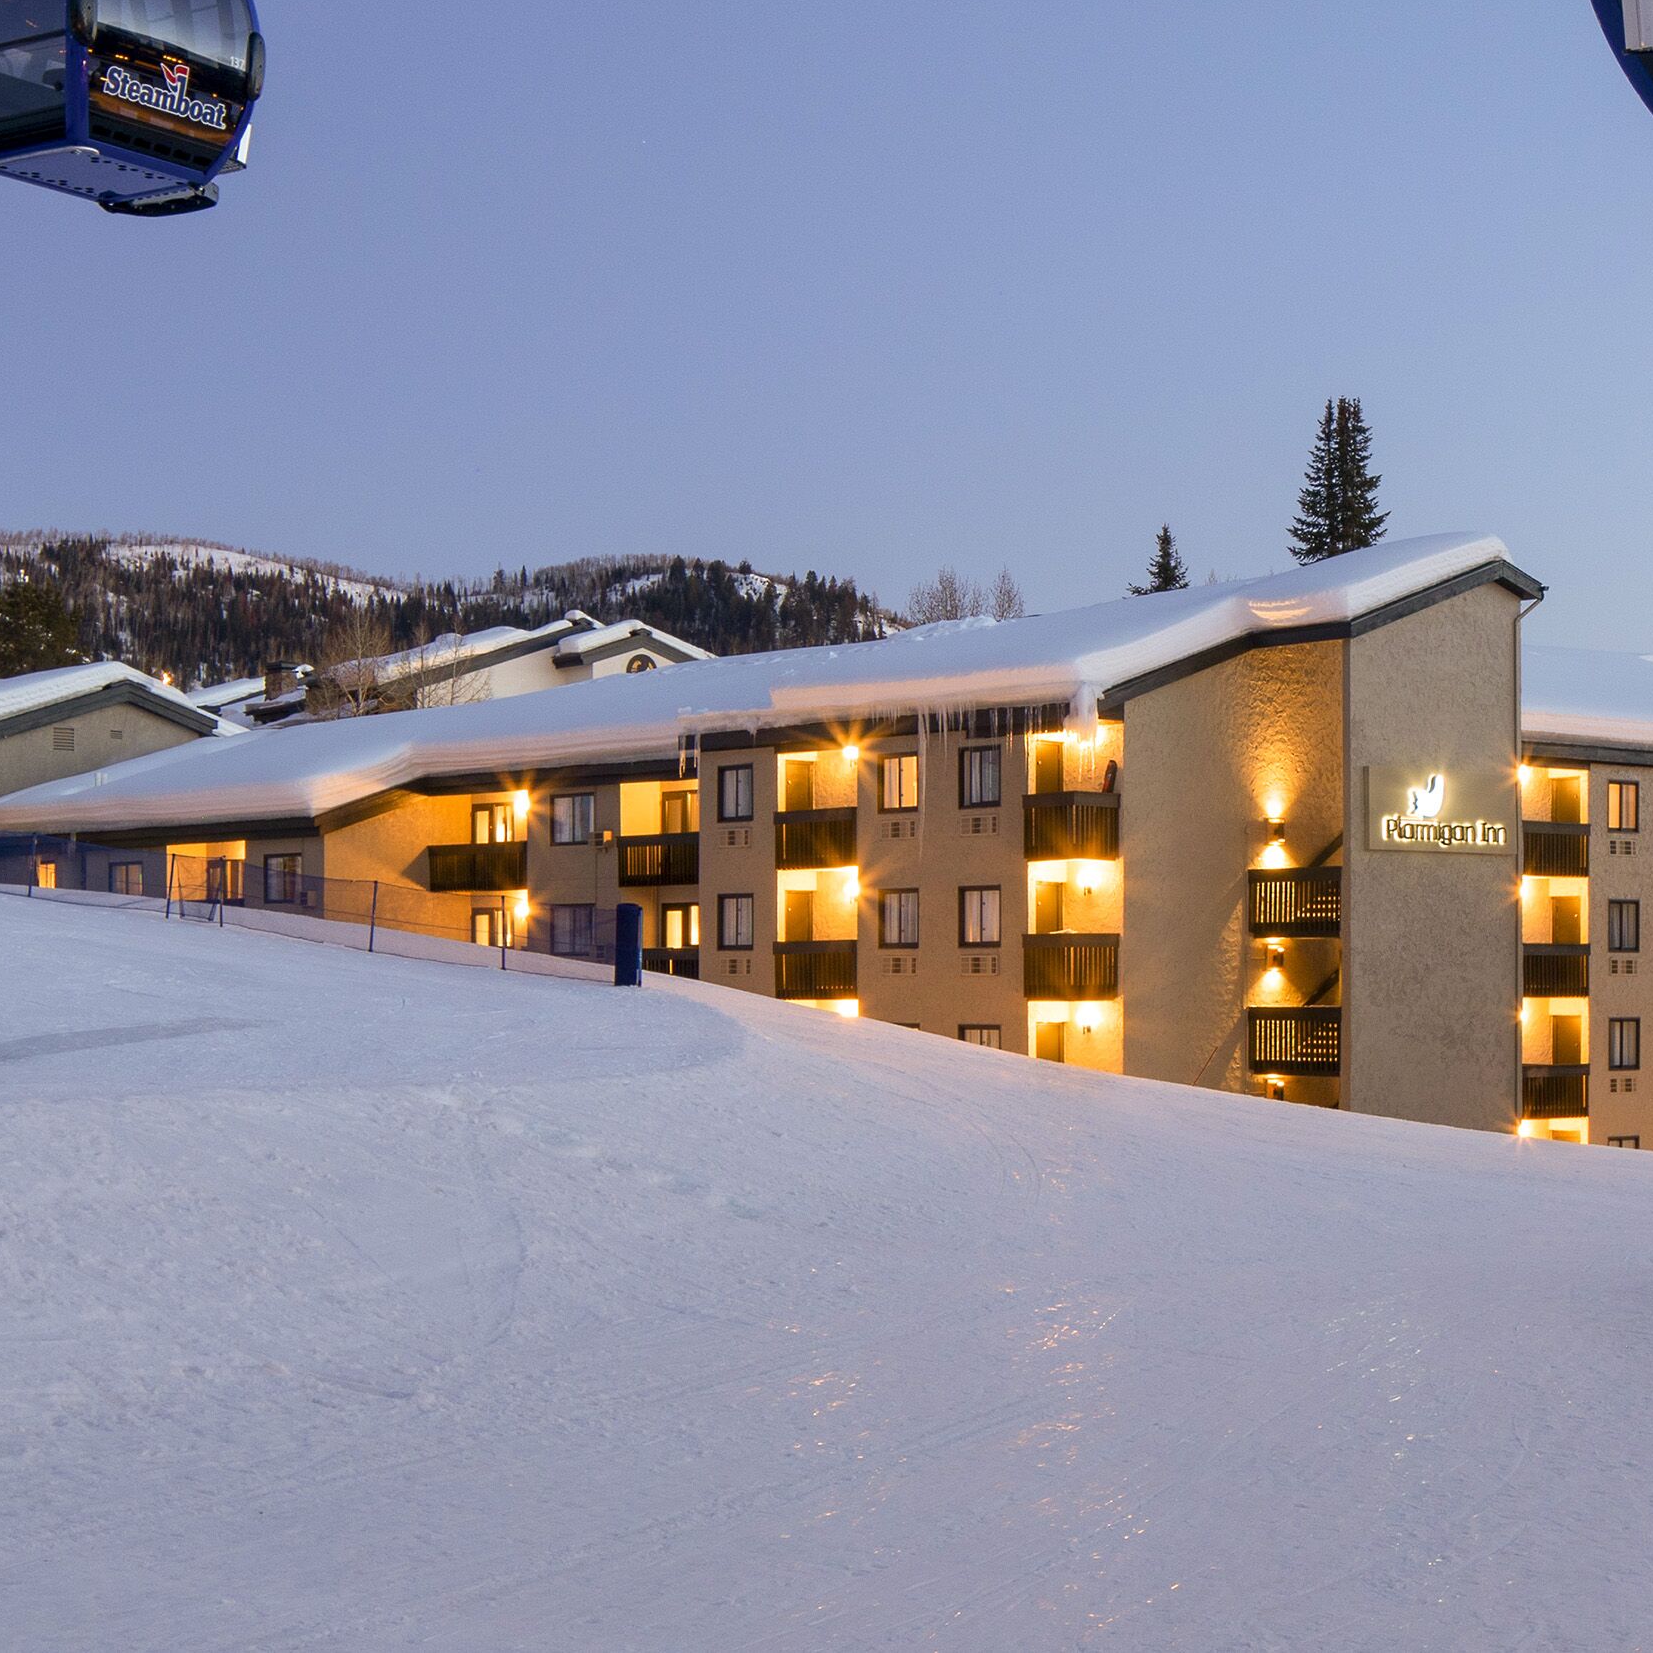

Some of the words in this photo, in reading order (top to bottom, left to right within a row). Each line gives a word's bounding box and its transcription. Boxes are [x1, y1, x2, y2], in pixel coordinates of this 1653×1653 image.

[230, 56, 246, 71] 137
[103, 65, 227, 130] Steamboat
[1383, 815, 1476, 847] Ptarmigan
[1479, 821, 1508, 845] Inn
